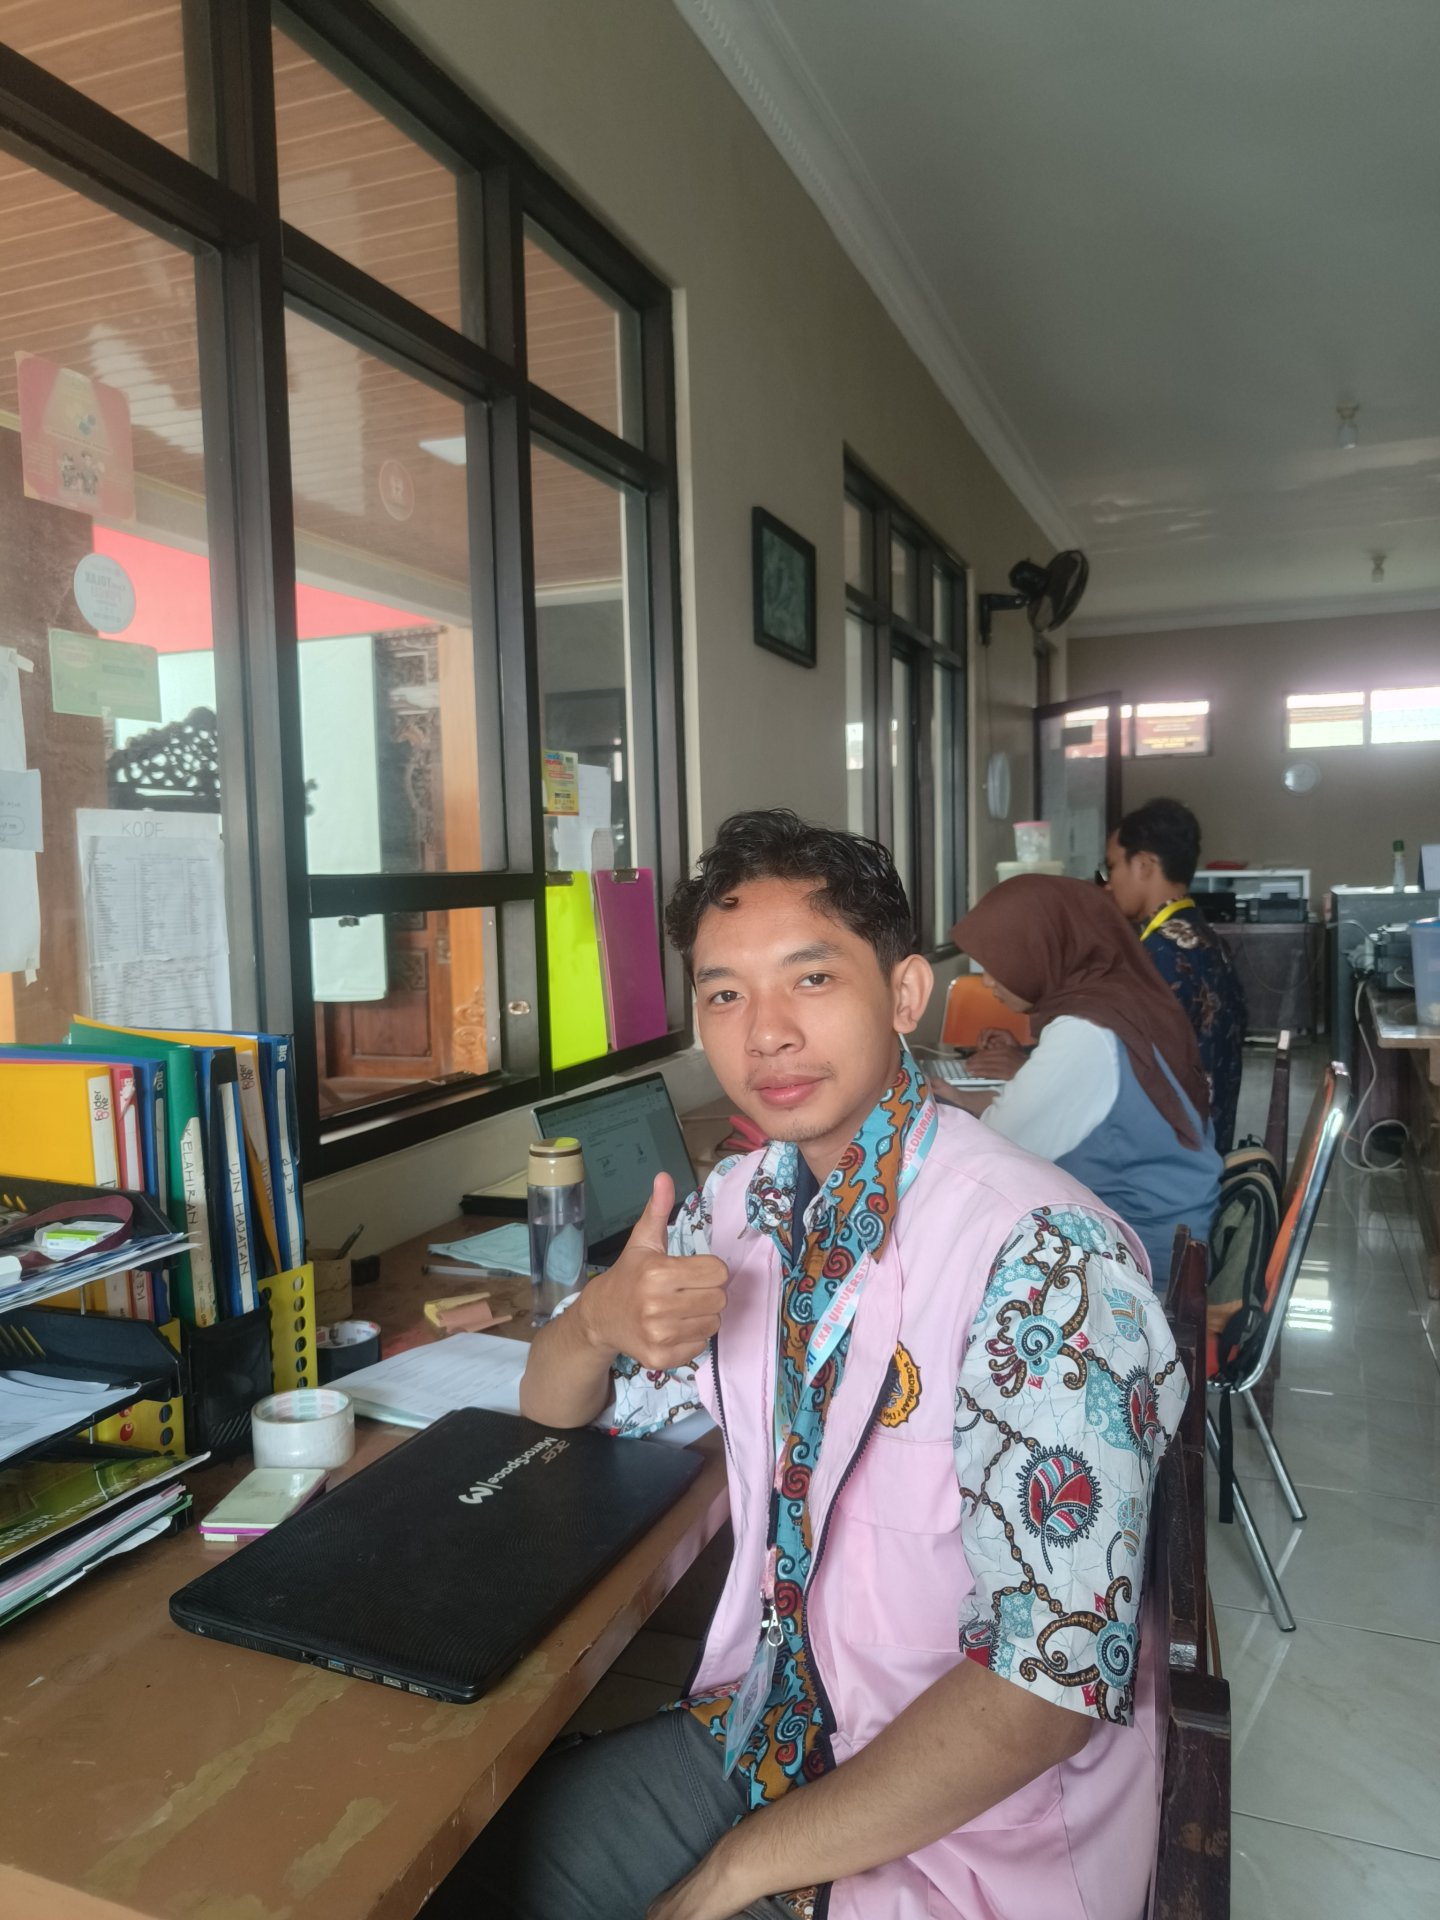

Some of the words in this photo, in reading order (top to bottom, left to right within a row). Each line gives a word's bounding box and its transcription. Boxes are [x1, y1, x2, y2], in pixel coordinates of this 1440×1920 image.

[279, 1045, 287, 1063] BIG
[182, 1125, 198, 1225] KELAHIRAN
[234, 1202, 250, 1276] HAJATAN
[813, 1323, 833, 1350] KKN
[487, 1436, 559, 1484] MirrorSpace
[540, 1440, 570, 1464] acer
